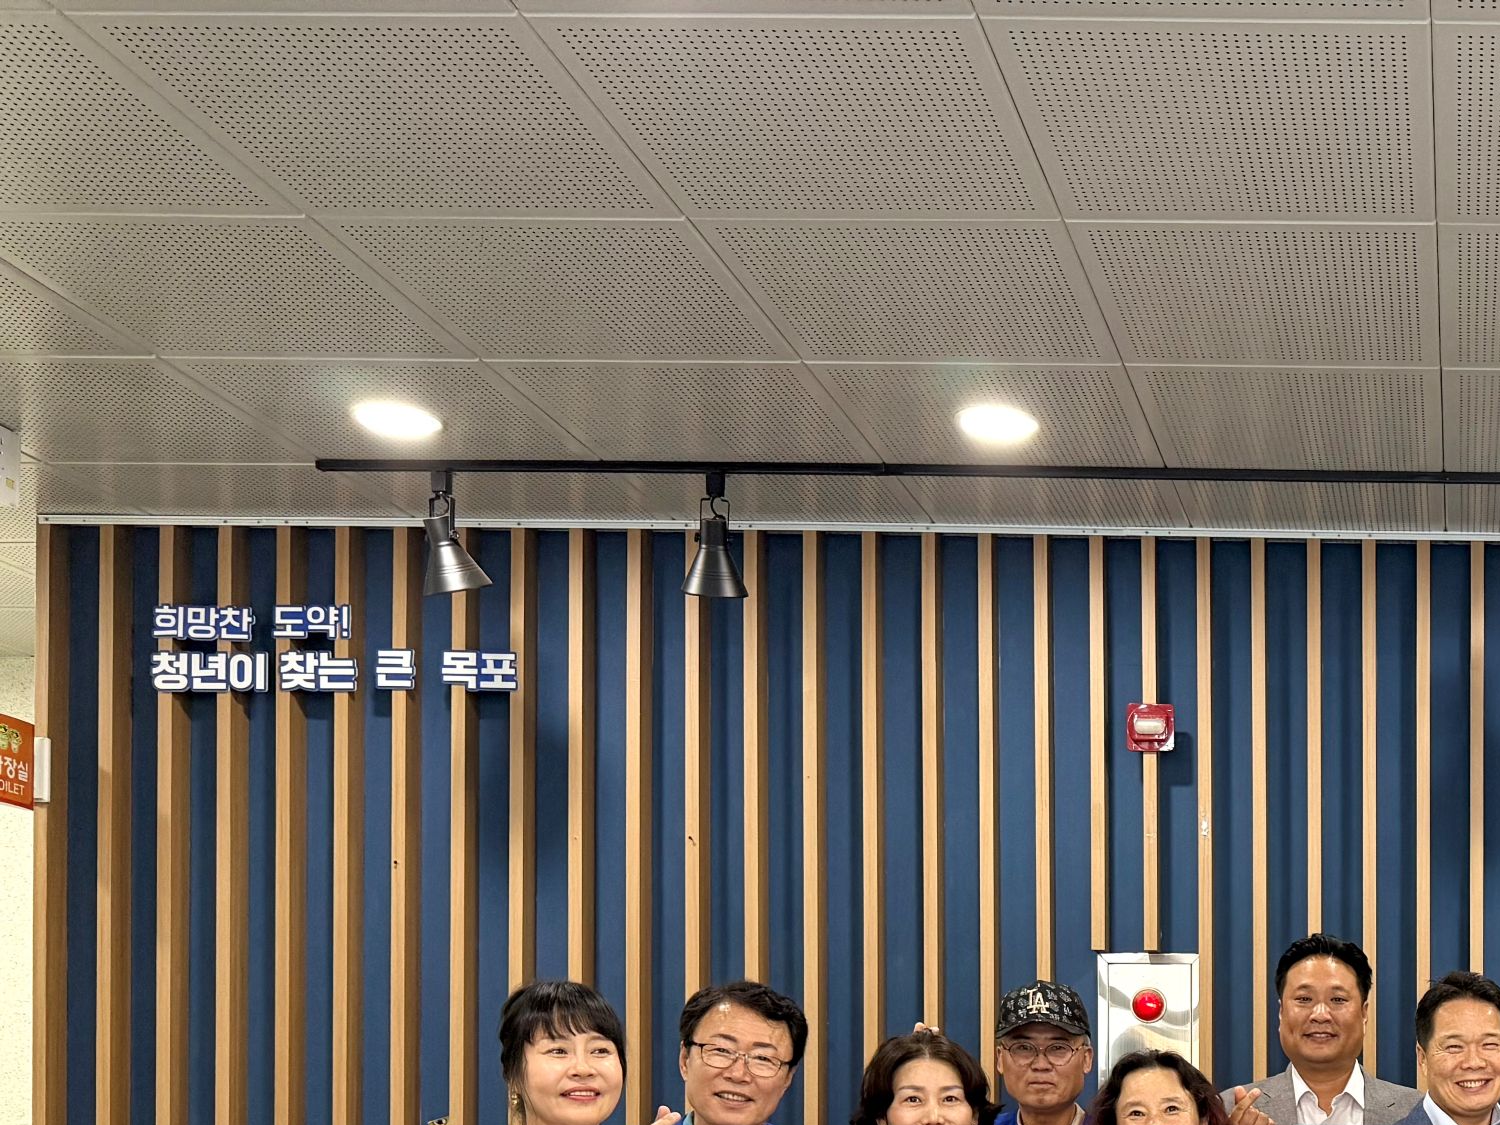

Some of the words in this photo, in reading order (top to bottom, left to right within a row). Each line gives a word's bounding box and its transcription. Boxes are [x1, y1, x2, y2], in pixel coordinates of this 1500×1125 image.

[153, 606, 252, 640] 희망찬
[273, 605, 350, 638] 도약!
[151, 652, 268, 692] 청년이
[280, 651, 357, 691] 찾는
[376, 648, 415, 690] 큰
[441, 651, 518, 691] 목포
[1027, 989, 1049, 1015] LA
